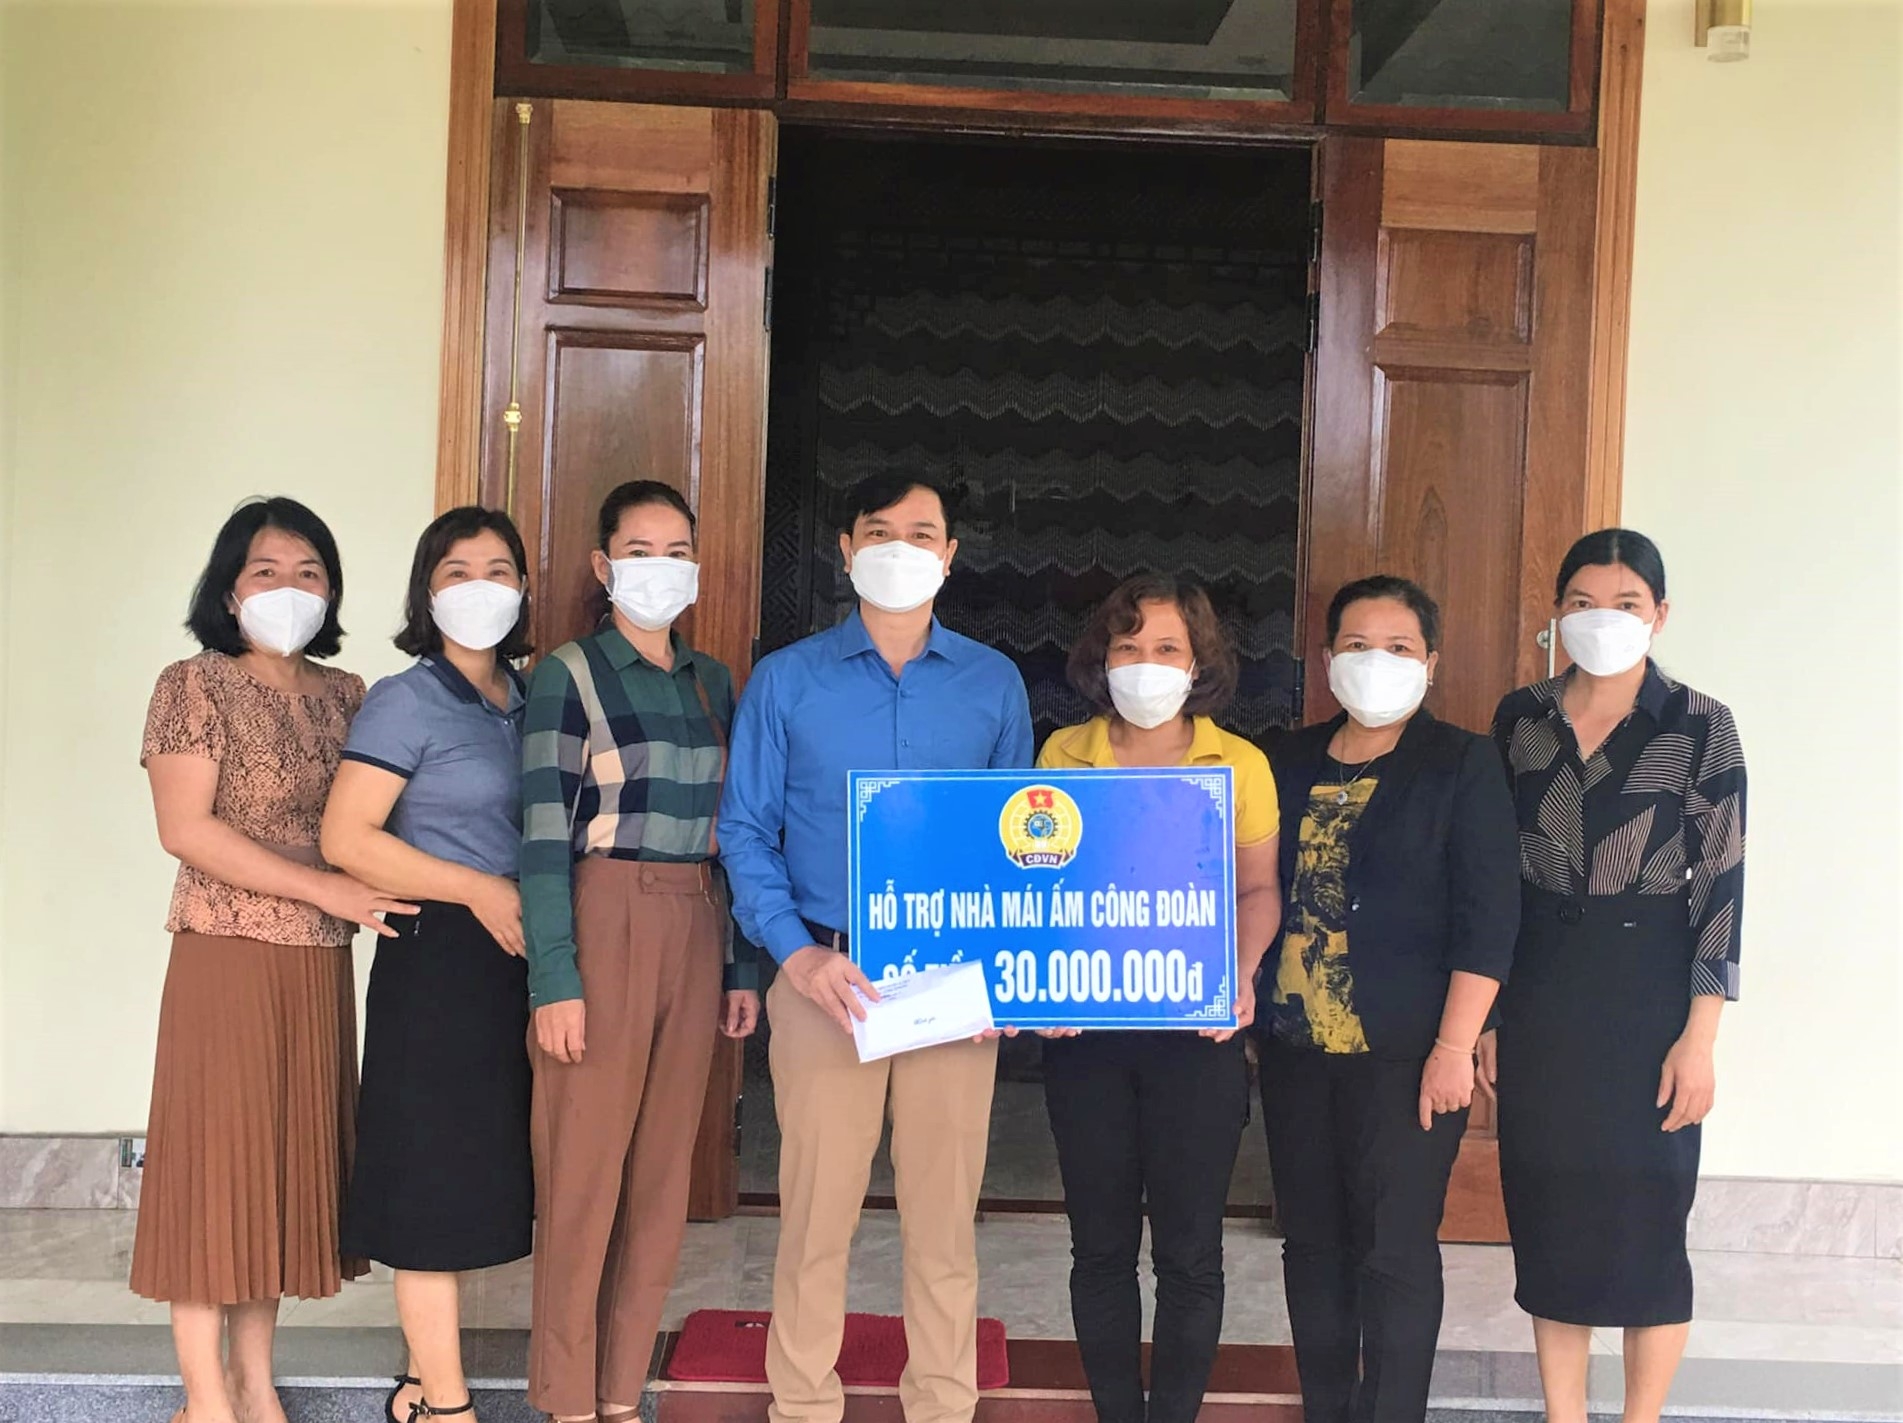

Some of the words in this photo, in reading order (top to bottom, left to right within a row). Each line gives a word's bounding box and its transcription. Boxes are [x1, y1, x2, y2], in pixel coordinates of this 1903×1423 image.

[1024, 853, 1059, 865] CĐVN
[868, 878, 898, 931] HỖ
[903, 888, 945, 938] TRỢ
[950, 883, 996, 929] NHÀ
[1001, 883, 1043, 928] MÁI
[1049, 877, 1085, 928] ẤM
[1090, 882, 1151, 928] CÔNG
[1155, 881, 1217, 928] ĐOÀN
[994, 949, 1204, 1004] 30.000.000đ
